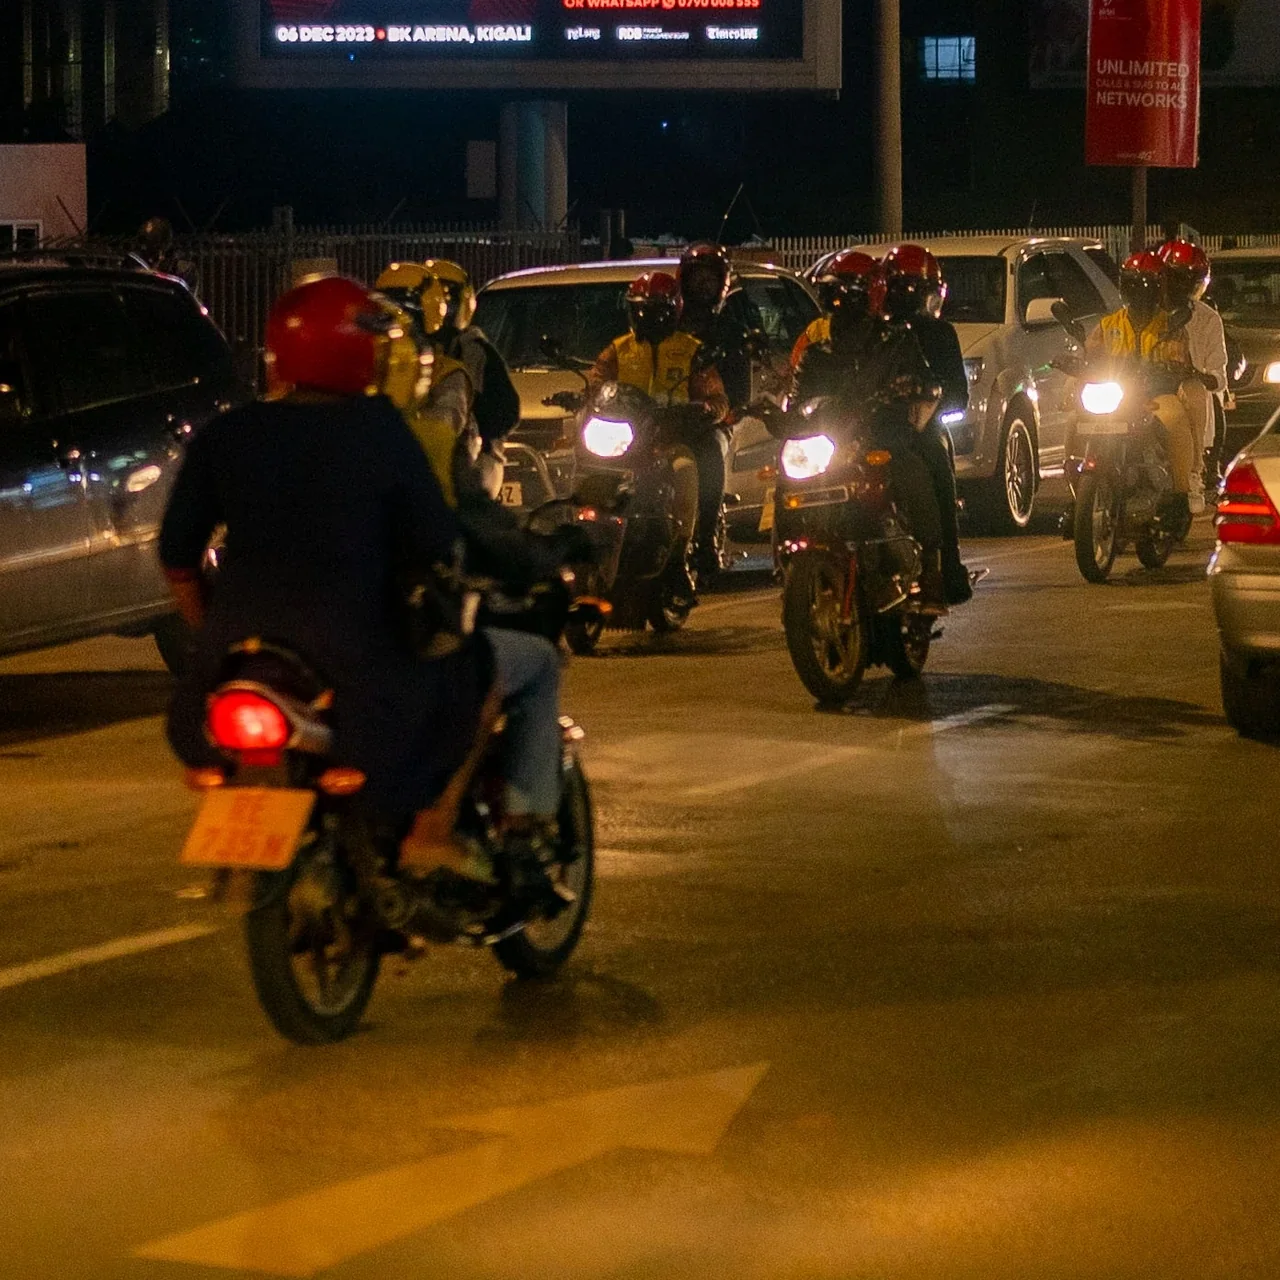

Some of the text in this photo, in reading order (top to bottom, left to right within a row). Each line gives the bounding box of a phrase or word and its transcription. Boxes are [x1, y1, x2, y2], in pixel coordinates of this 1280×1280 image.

[277, 25, 532, 43] 06 DEC 2023 BK ARENA, KIGALI
[1096, 59, 1190, 78] UNLIMITED
[1157, 81, 1169, 90] TO
[1096, 91, 1188, 109] NETWORKS
